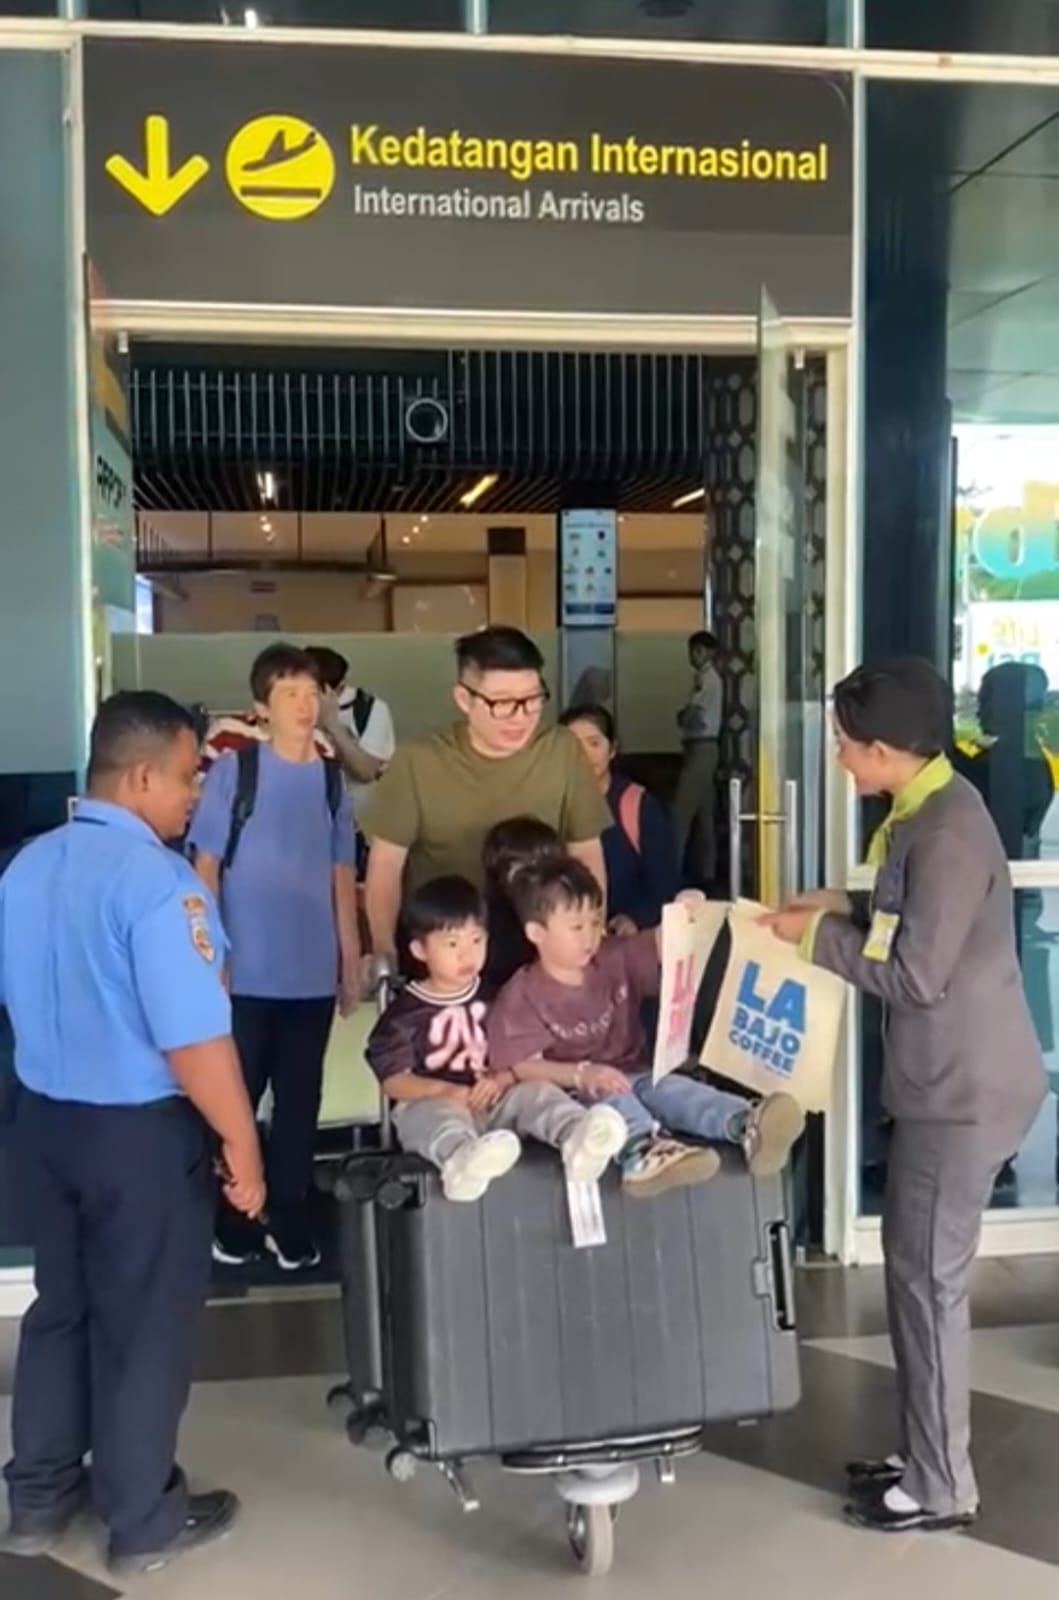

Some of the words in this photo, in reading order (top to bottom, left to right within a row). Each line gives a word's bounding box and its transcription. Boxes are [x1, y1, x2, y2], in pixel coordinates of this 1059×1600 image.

[351, 124, 578, 180] Kedatangan
[591, 132, 827, 181] Internasional
[354, 184, 531, 219] International
[537, 190, 645, 223] Arrivals
[737, 959, 806, 1035] LA
[728, 1029, 794, 1074] COFFEE
[733, 1006, 800, 1056] BAJO
